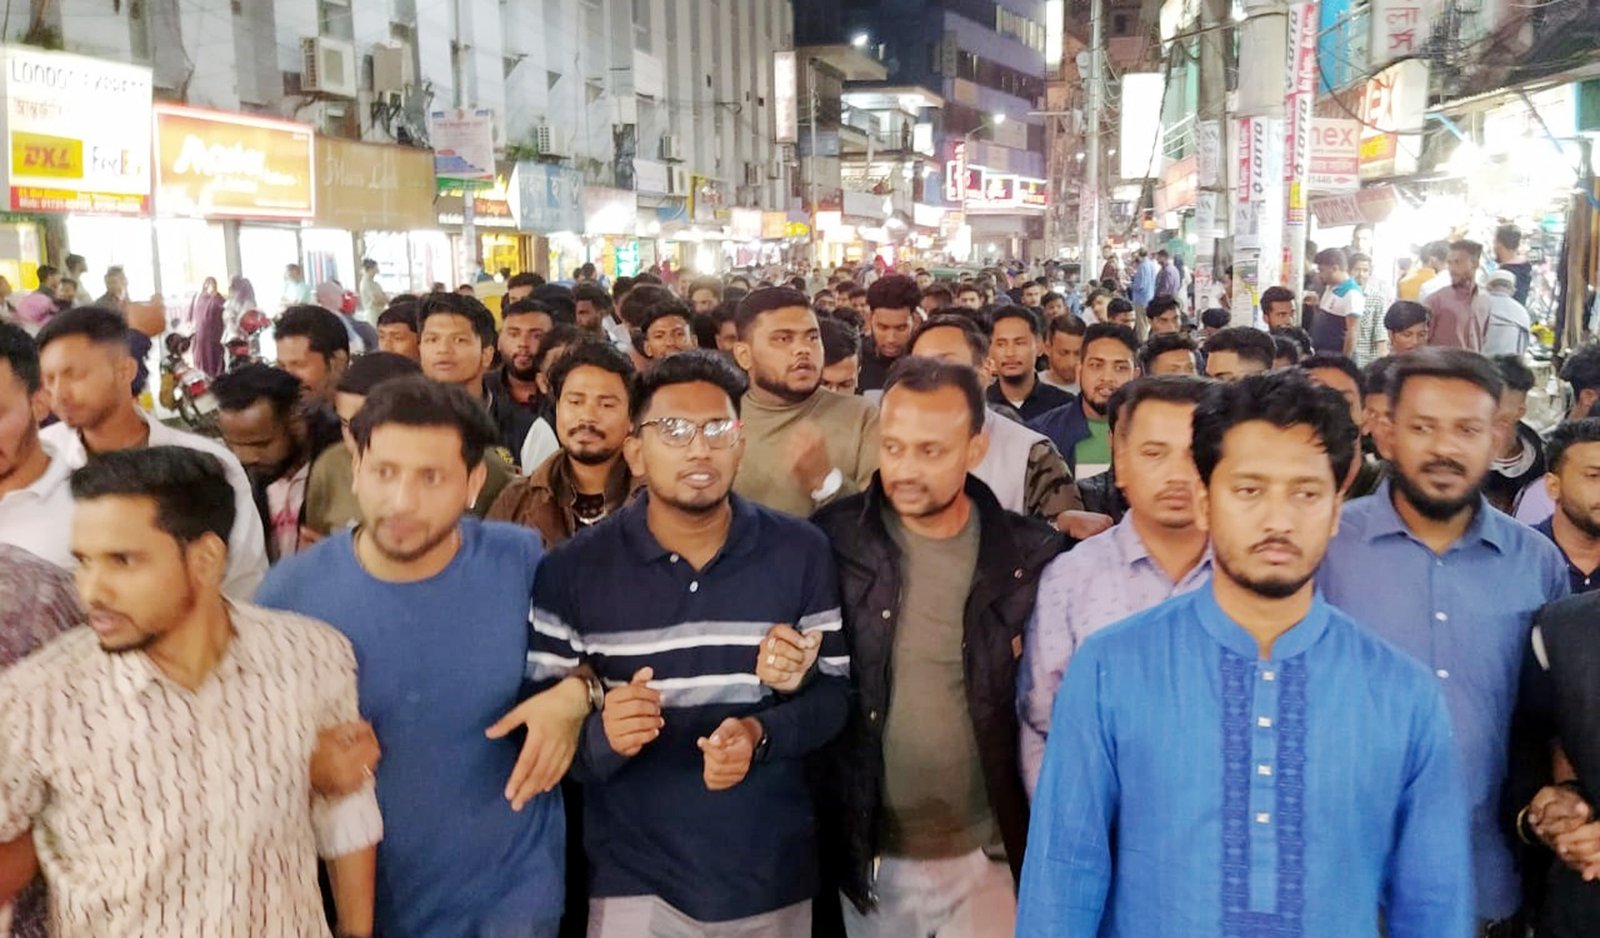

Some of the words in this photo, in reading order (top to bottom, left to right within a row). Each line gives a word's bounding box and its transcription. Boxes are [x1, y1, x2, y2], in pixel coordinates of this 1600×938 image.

[1287, 10, 1299, 72] LOTTO
[1252, 122, 1264, 180] LOTTO
[1295, 99, 1308, 165] LOTTO
